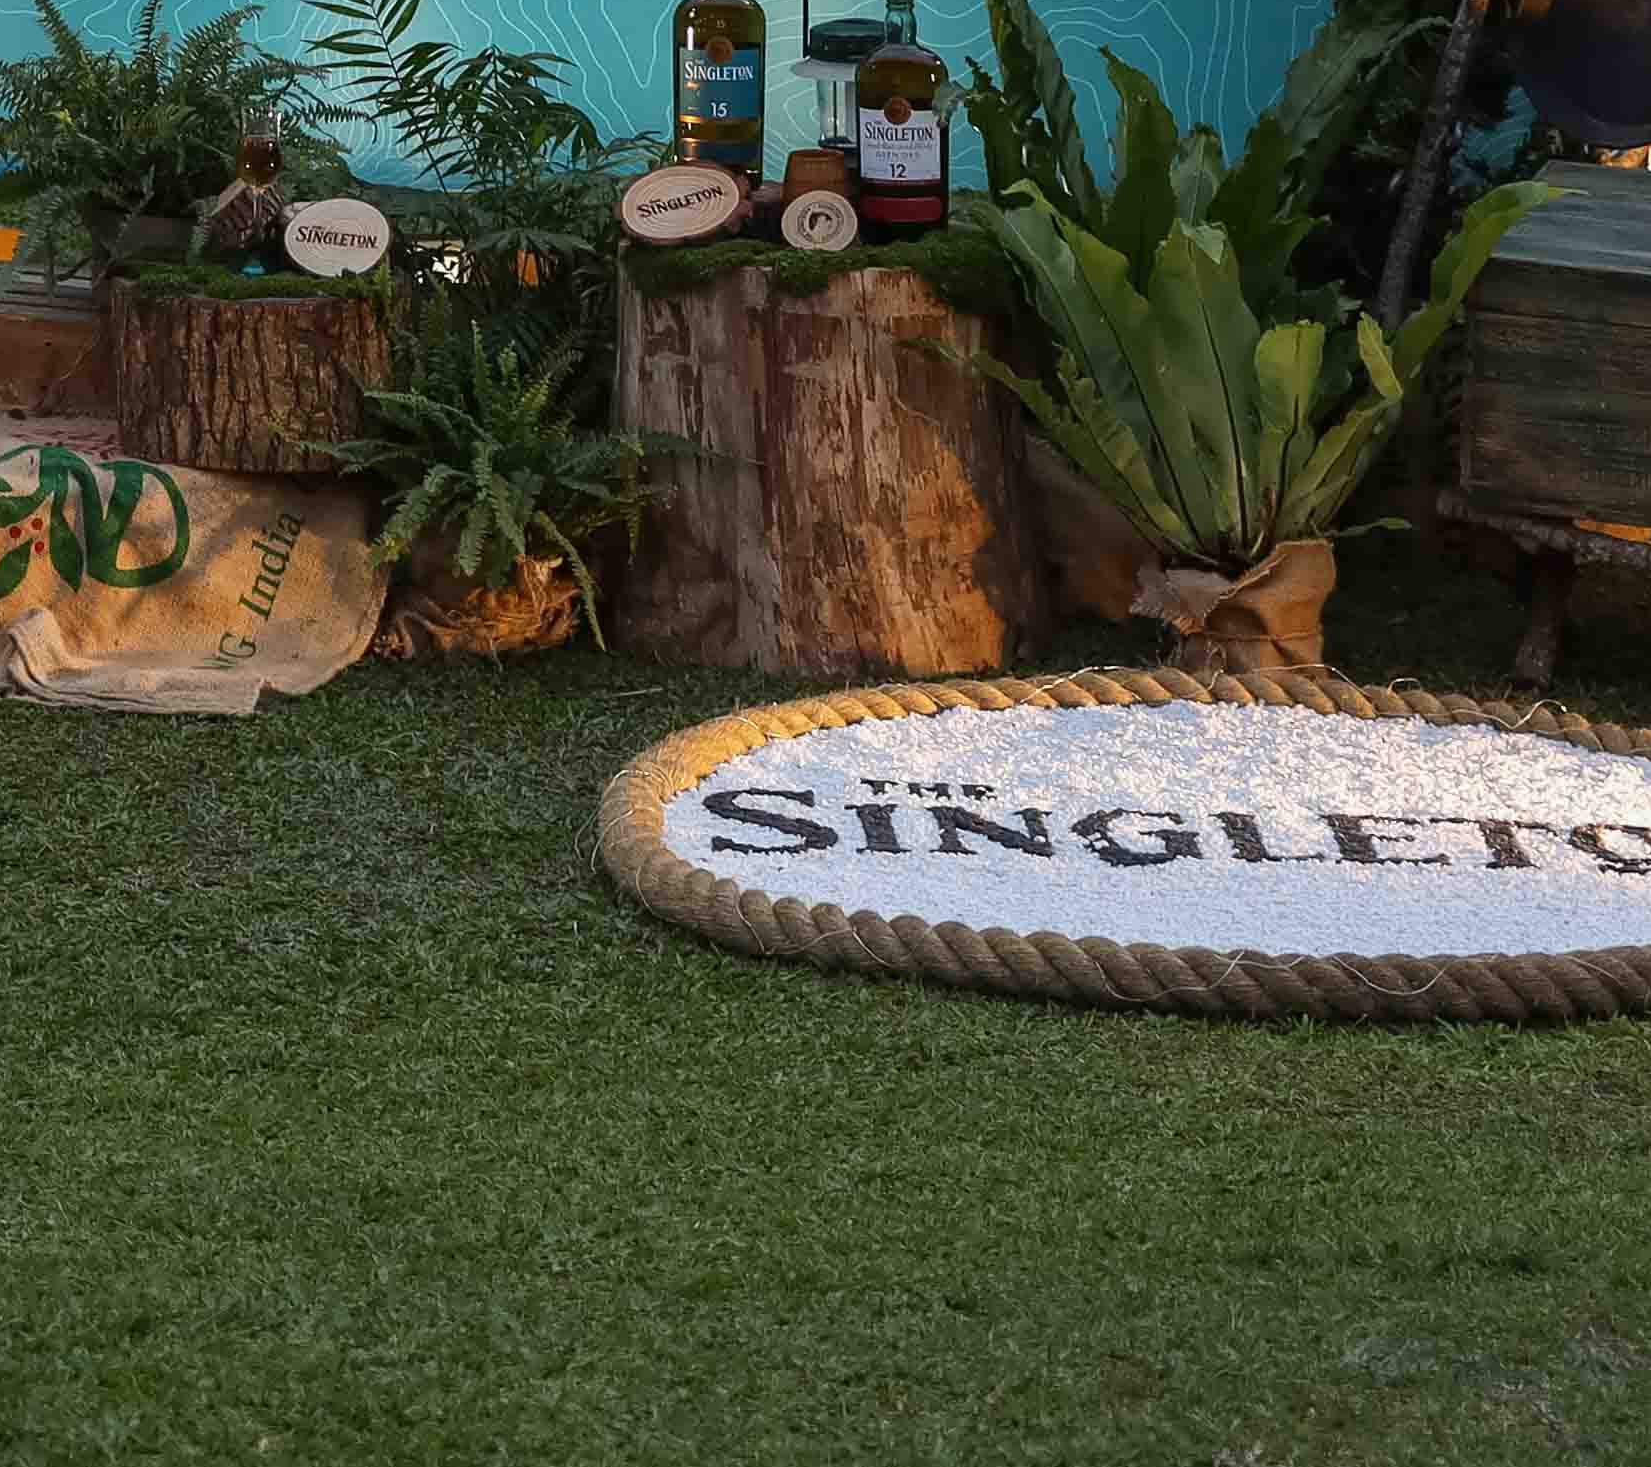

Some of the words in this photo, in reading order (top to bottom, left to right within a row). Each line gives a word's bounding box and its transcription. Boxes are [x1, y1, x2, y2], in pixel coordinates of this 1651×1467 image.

[684, 61, 754, 82] SINGLETON
[711, 102, 728, 117] 15
[865, 121, 935, 142] SINGLETON
[890, 163, 907, 179] 12
[638, 185, 723, 217] SINGLETON
[296, 225, 378, 249] SINGLETON
[238, 513, 306, 619] India
